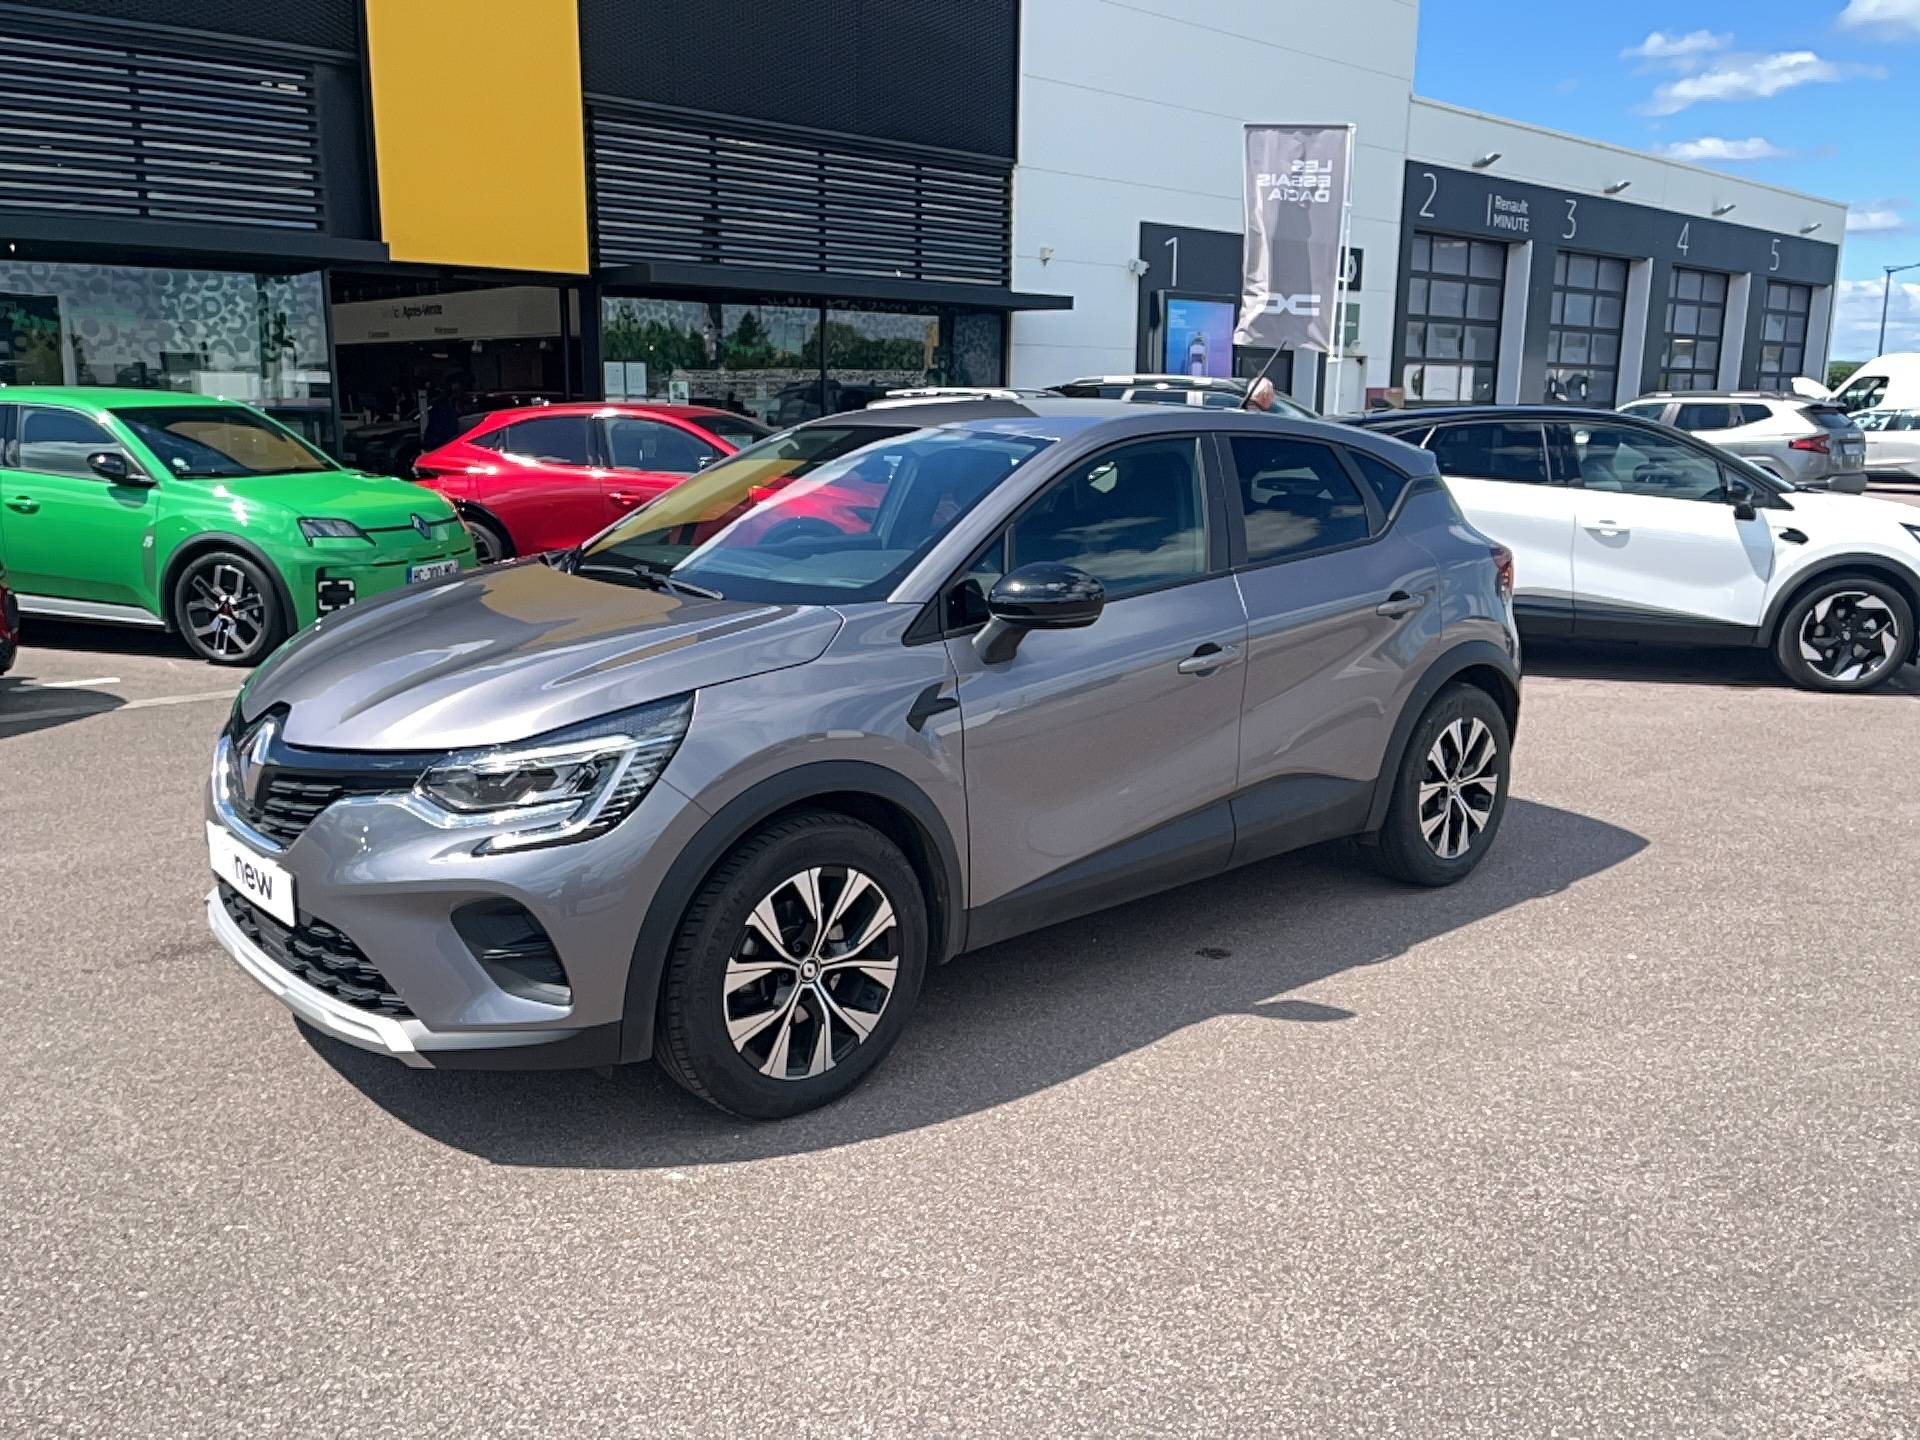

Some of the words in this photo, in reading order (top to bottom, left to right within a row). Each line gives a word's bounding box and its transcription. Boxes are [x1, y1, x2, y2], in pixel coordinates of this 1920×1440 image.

[1419, 172, 1438, 218] 2
[1494, 195, 1529, 215] Renault
[1493, 213, 1530, 233] MINUTE
[1562, 199, 1578, 239] 3
[1676, 222, 1690, 256] 4
[1769, 238, 1781, 271] 5
[1164, 236, 1178, 287] 1
[233, 853, 273, 900] new
